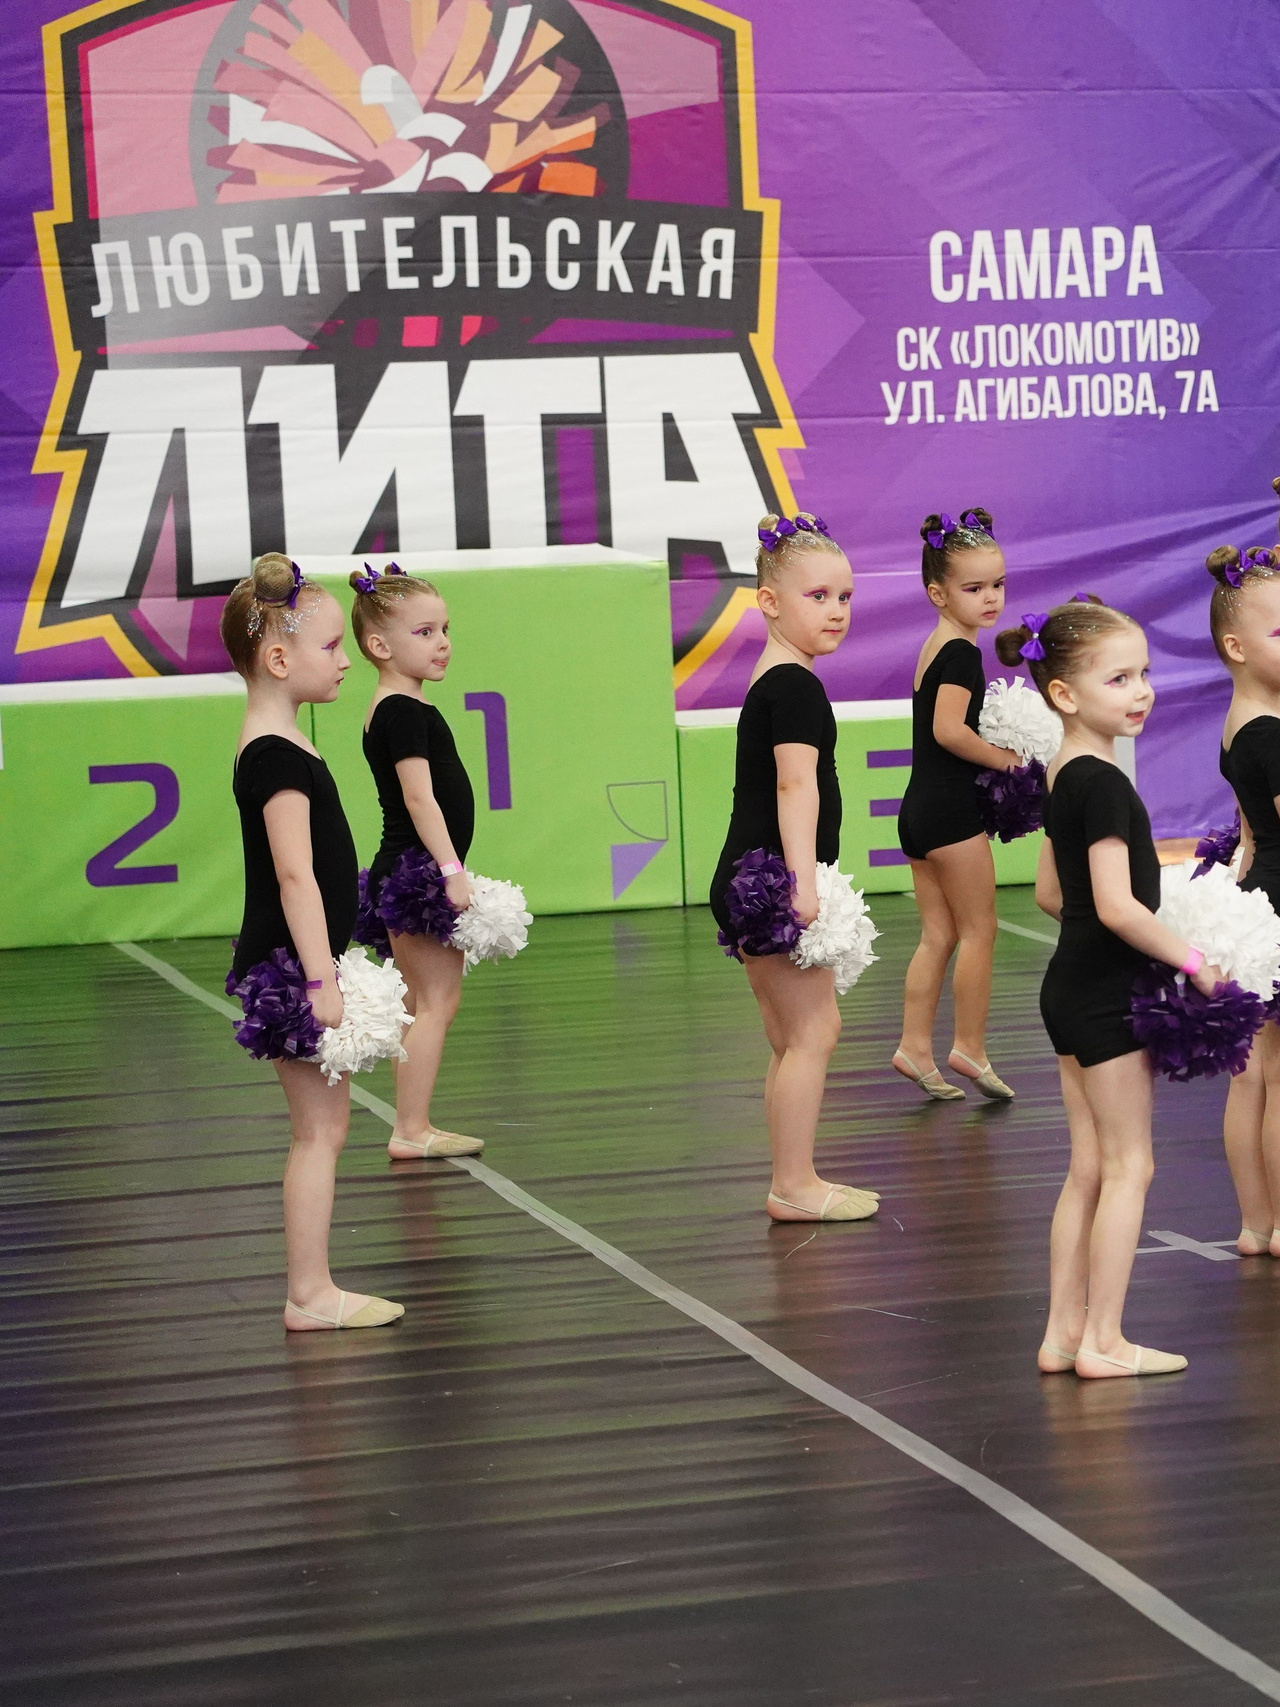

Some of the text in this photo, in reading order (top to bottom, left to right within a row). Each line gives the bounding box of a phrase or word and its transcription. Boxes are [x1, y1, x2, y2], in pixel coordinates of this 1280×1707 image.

[91, 215, 736, 318] ЛЮБИТЕЛЬСКАЯ
[929, 225, 1164, 303] САМАРА
[897, 318, 1200, 372] СК «ЛОКОМОТИВ»
[880, 370, 1220, 426] УЛ. АГИБАЛОВА, 7А
[60, 352, 770, 608] ЛИГА
[464, 691, 512, 811] 1
[85, 762, 180, 888] 2
